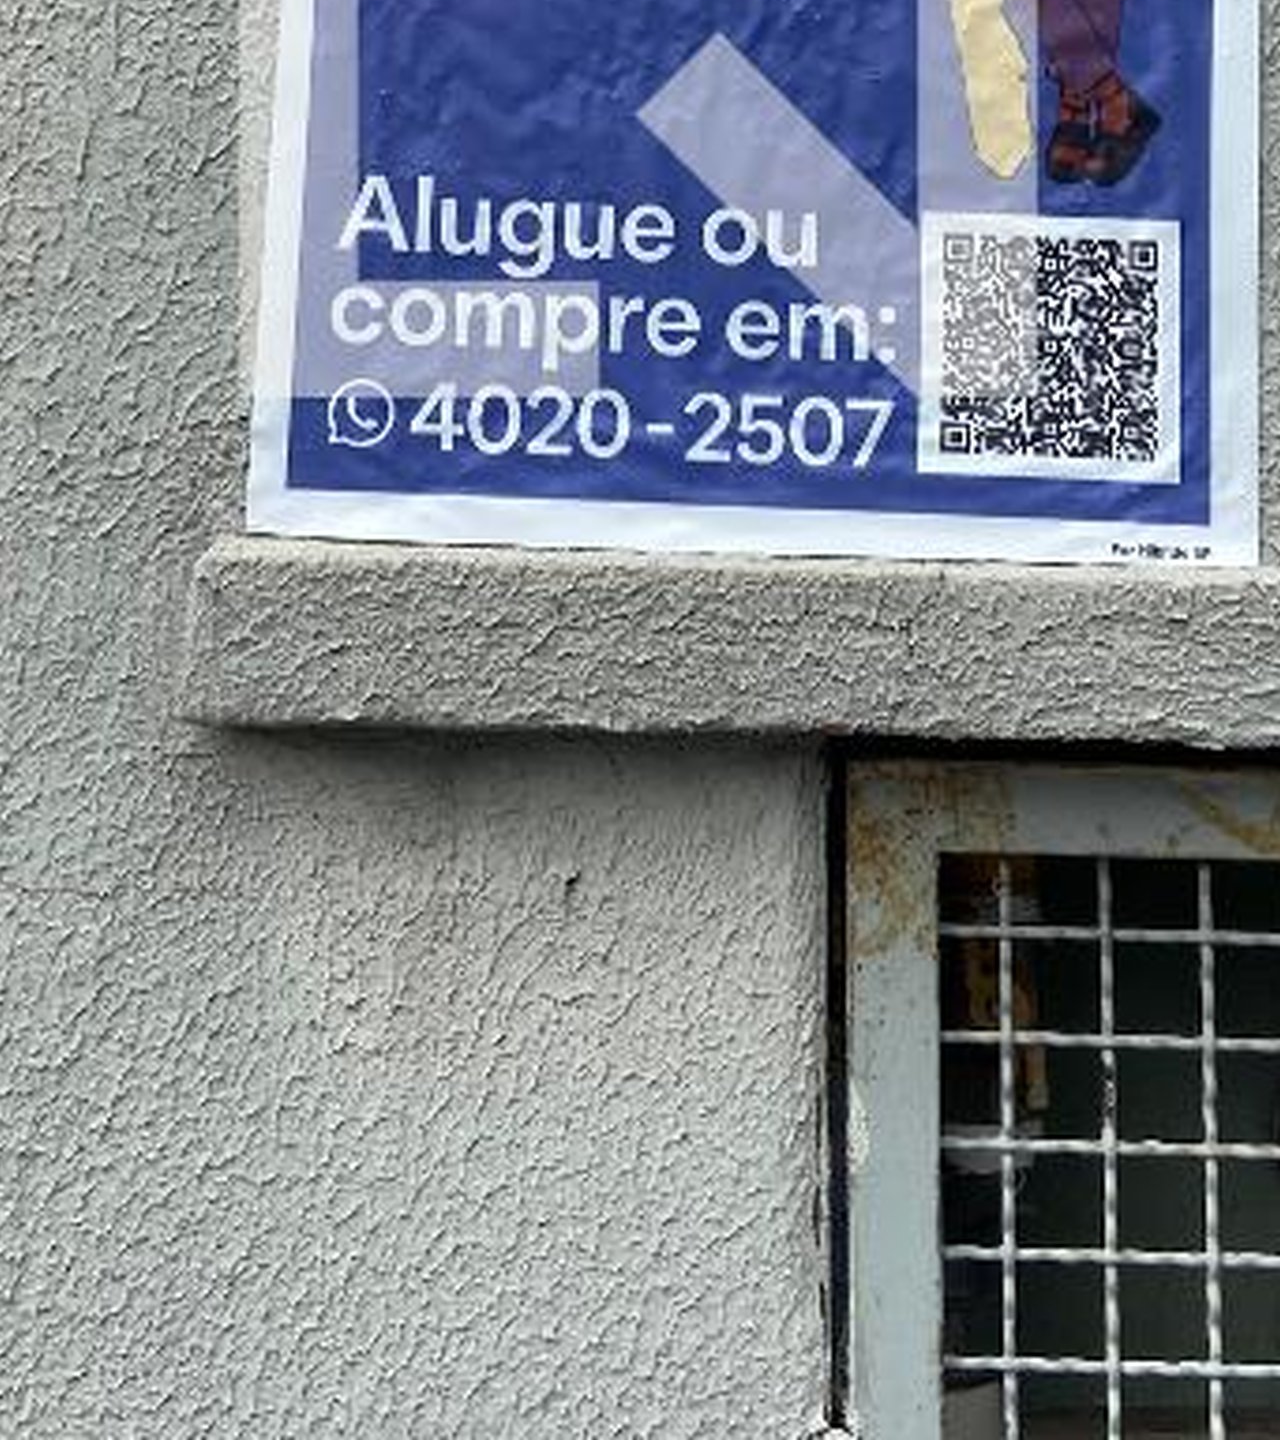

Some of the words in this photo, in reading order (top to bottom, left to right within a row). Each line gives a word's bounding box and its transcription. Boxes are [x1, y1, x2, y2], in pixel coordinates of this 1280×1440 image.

[337, 174, 678, 278] Alugue
[702, 208, 818, 268] ou
[330, 286, 701, 372] compre
[725, 298, 898, 361] em:
